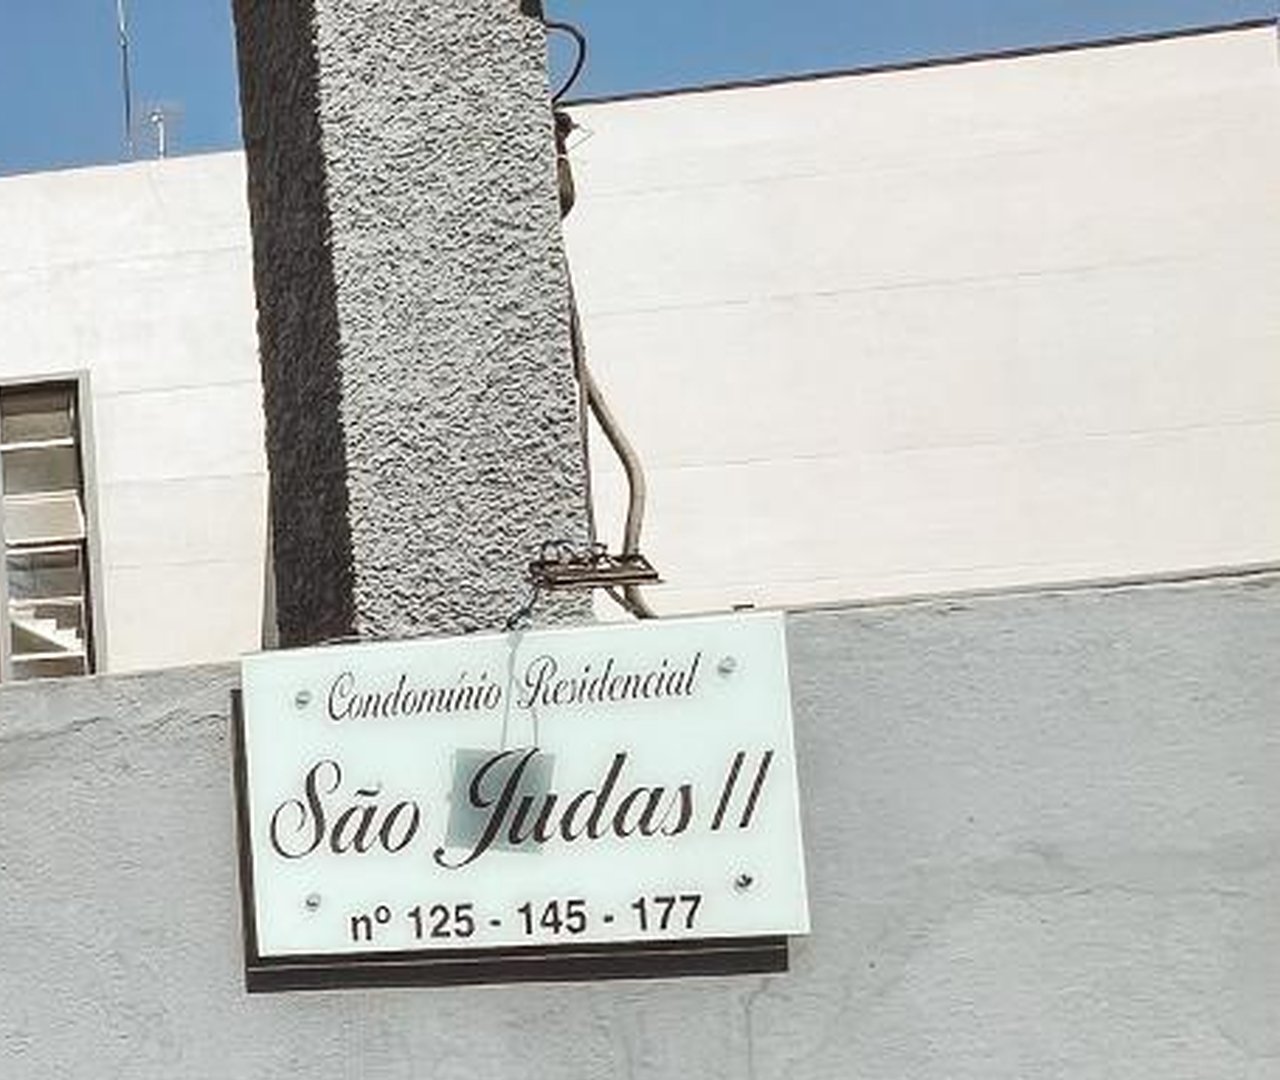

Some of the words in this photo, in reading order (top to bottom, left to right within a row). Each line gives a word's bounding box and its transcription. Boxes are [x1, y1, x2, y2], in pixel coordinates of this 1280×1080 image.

[327, 671, 503, 722] Condomínio
[516, 651, 703, 709] Residencial
[269, 759, 421, 859] São
[433, 748, 694, 869] Judas
[407, 904, 475, 940] 125
[517, 899, 587, 935] 145
[632, 894, 703, 931] 177
